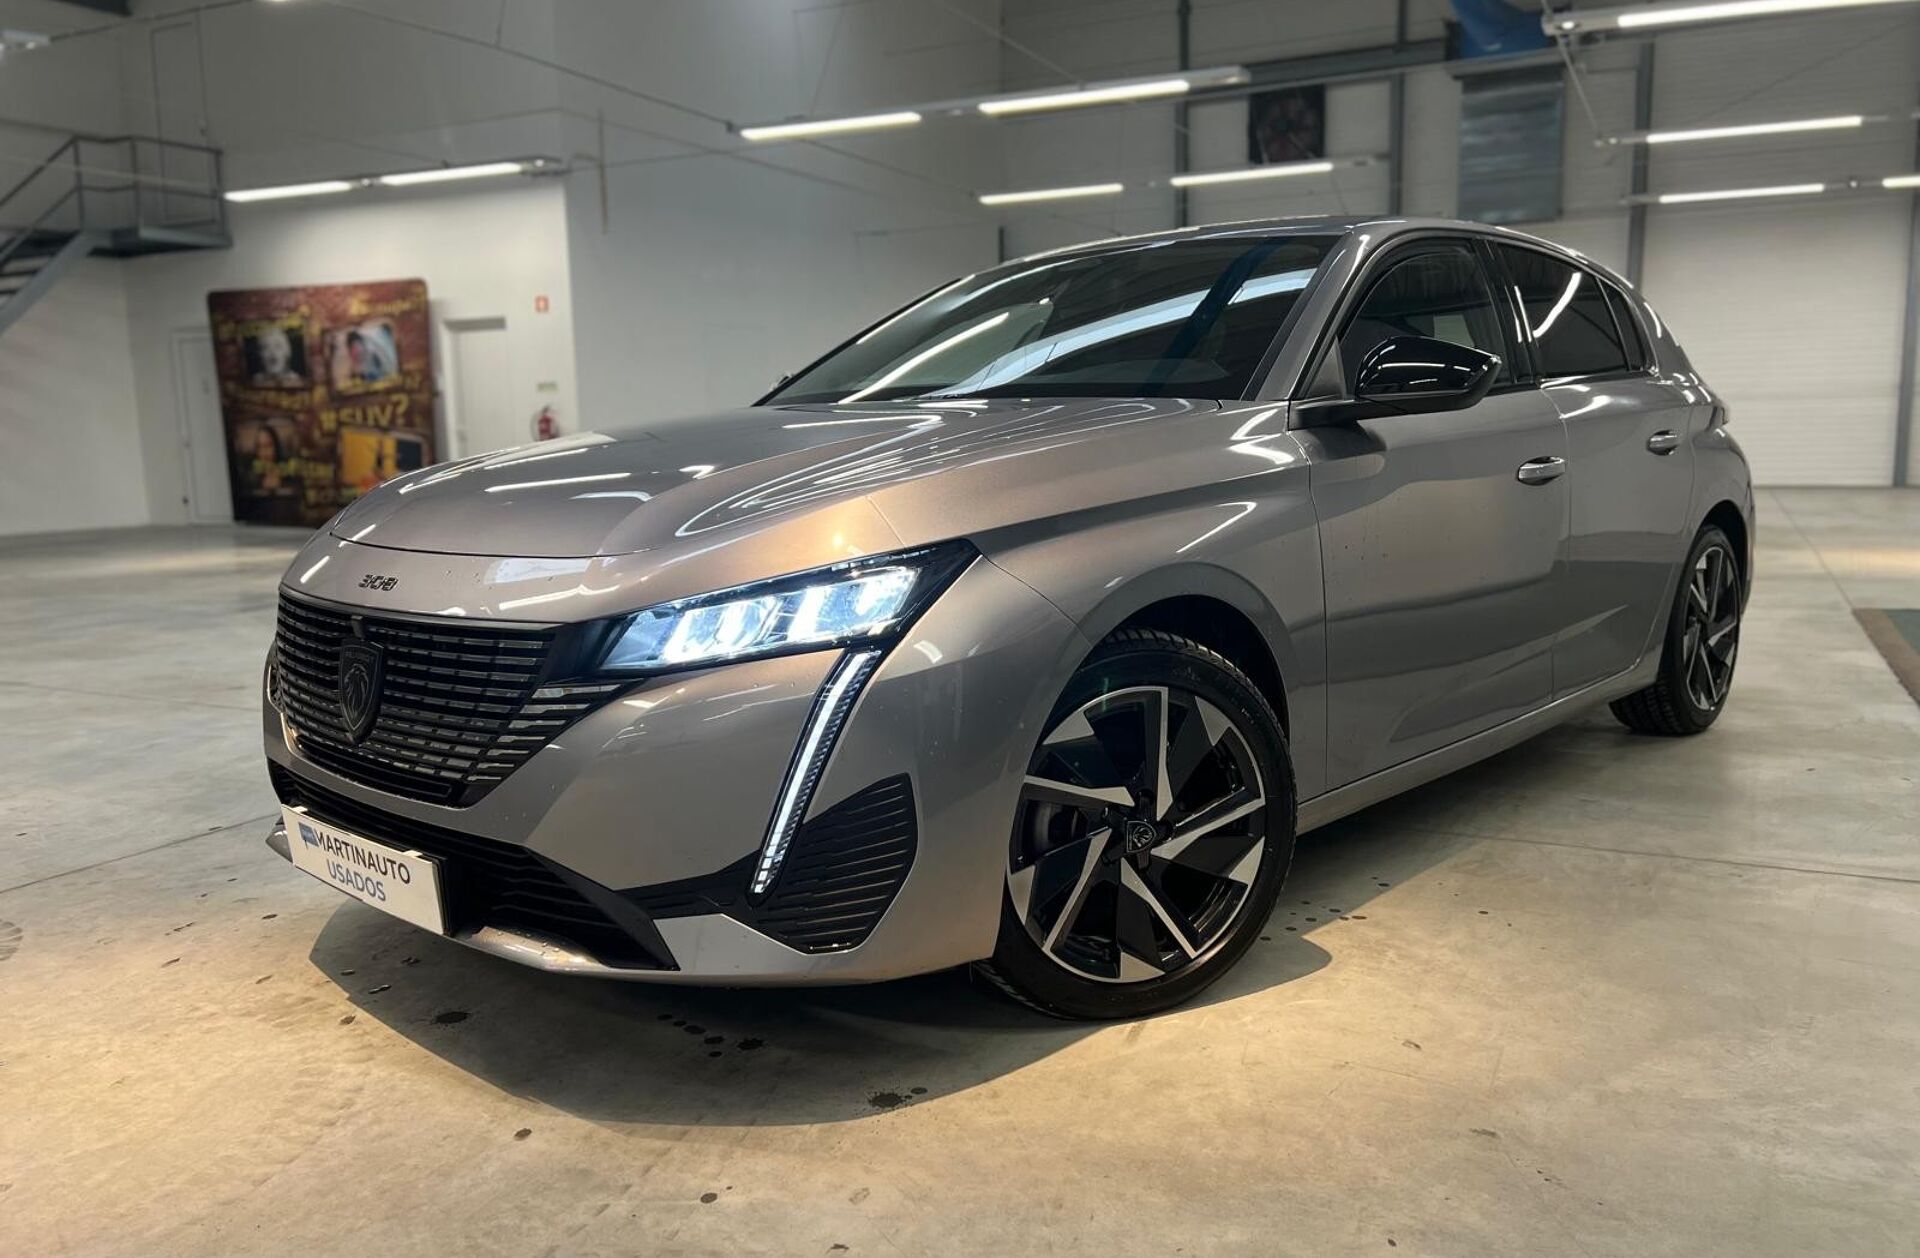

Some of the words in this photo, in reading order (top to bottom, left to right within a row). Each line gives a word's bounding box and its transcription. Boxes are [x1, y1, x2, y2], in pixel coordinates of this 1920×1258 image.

[358, 574, 399, 591] 308
[314, 829, 411, 884] MARTINAUTO
[327, 859, 386, 901] USADOS
